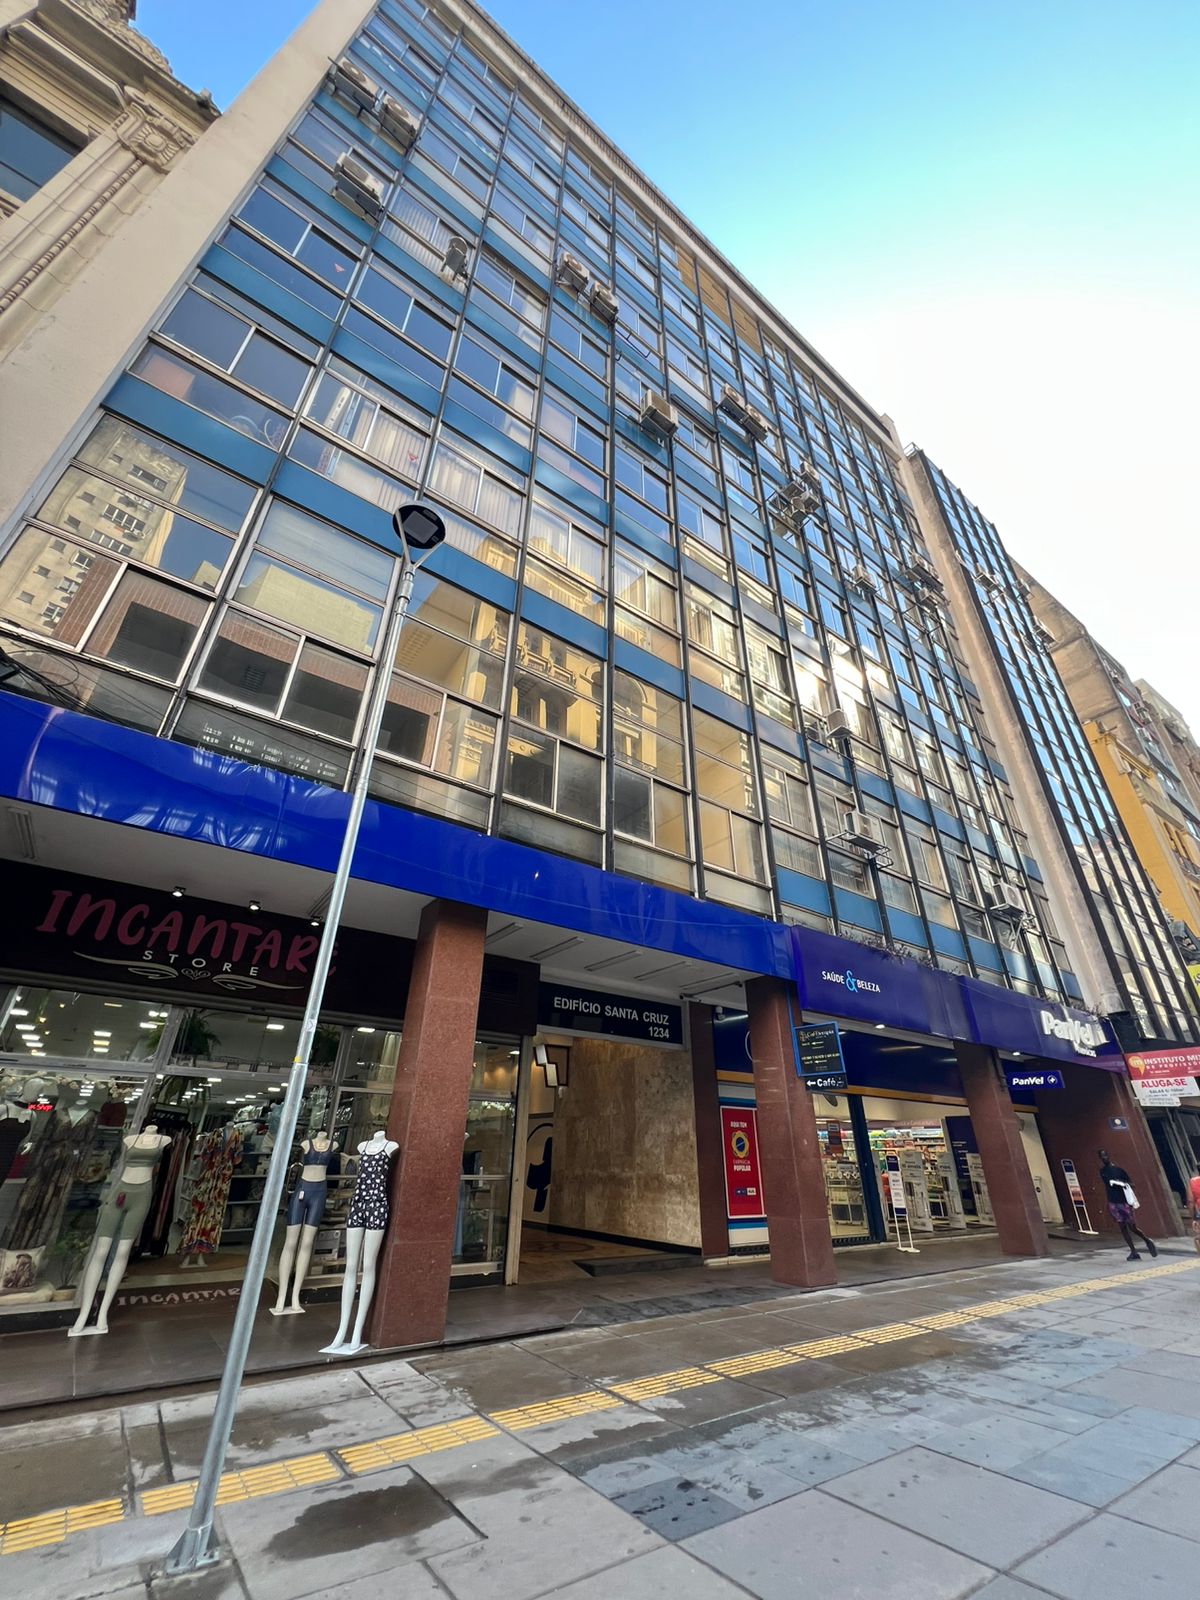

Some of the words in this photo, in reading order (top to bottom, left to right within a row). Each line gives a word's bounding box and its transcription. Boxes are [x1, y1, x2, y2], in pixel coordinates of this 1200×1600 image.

[142, 950, 259, 977] STORE
[822, 971, 845, 984] SAÚDE
[846, 970, 858, 993] &
[857, 979, 880, 993] BELEZA
[554, 997, 601, 1015] EDIFÍCIO
[604, 1005, 638, 1021] SANTA
[643, 1012, 669, 1025] CRUZ
[648, 1026, 669, 1038] 1234
[1144, 1055, 1185, 1065] INSTITUTO
[817, 1078, 836, 1087] Café
[1141, 1079, 1187, 1088] ALUGA-SE
[117, 1287, 241, 1306] INCANTAR
